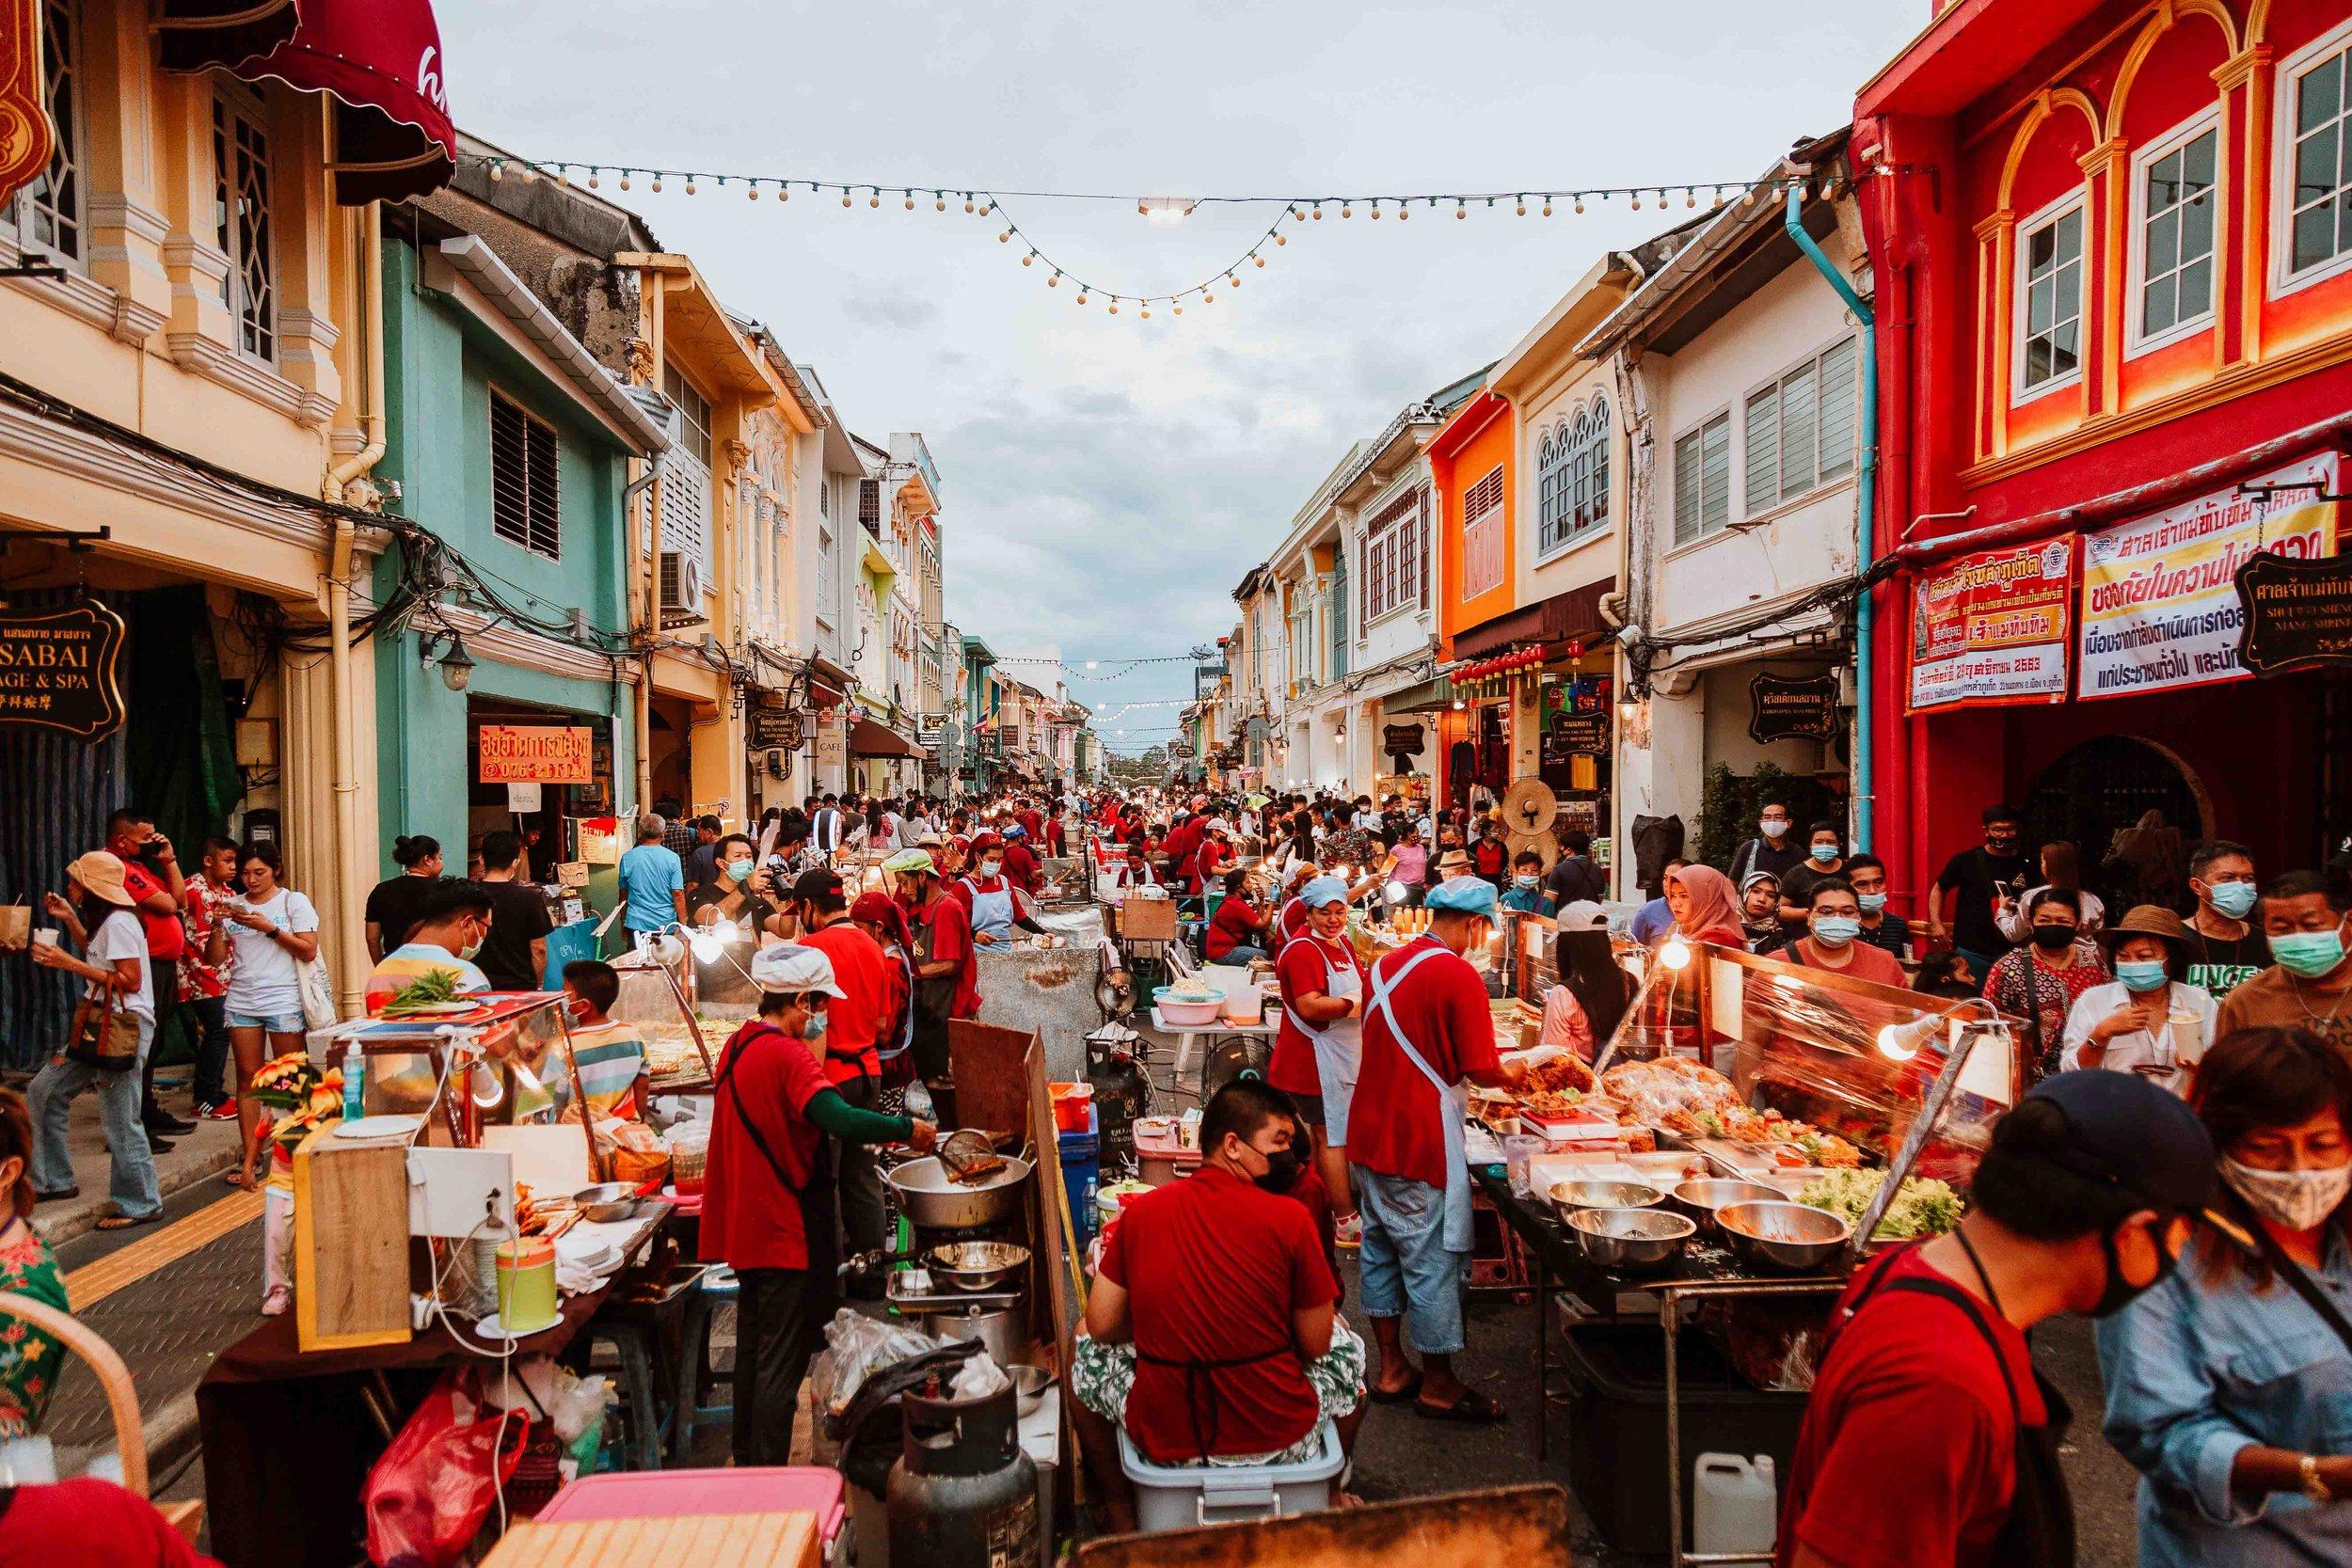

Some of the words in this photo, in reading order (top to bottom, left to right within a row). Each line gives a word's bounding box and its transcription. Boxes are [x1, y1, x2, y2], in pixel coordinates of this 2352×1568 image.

[0, 643, 88, 668] SABAI
[37, 673, 50, 688] &
[56, 673, 88, 689] SPA
